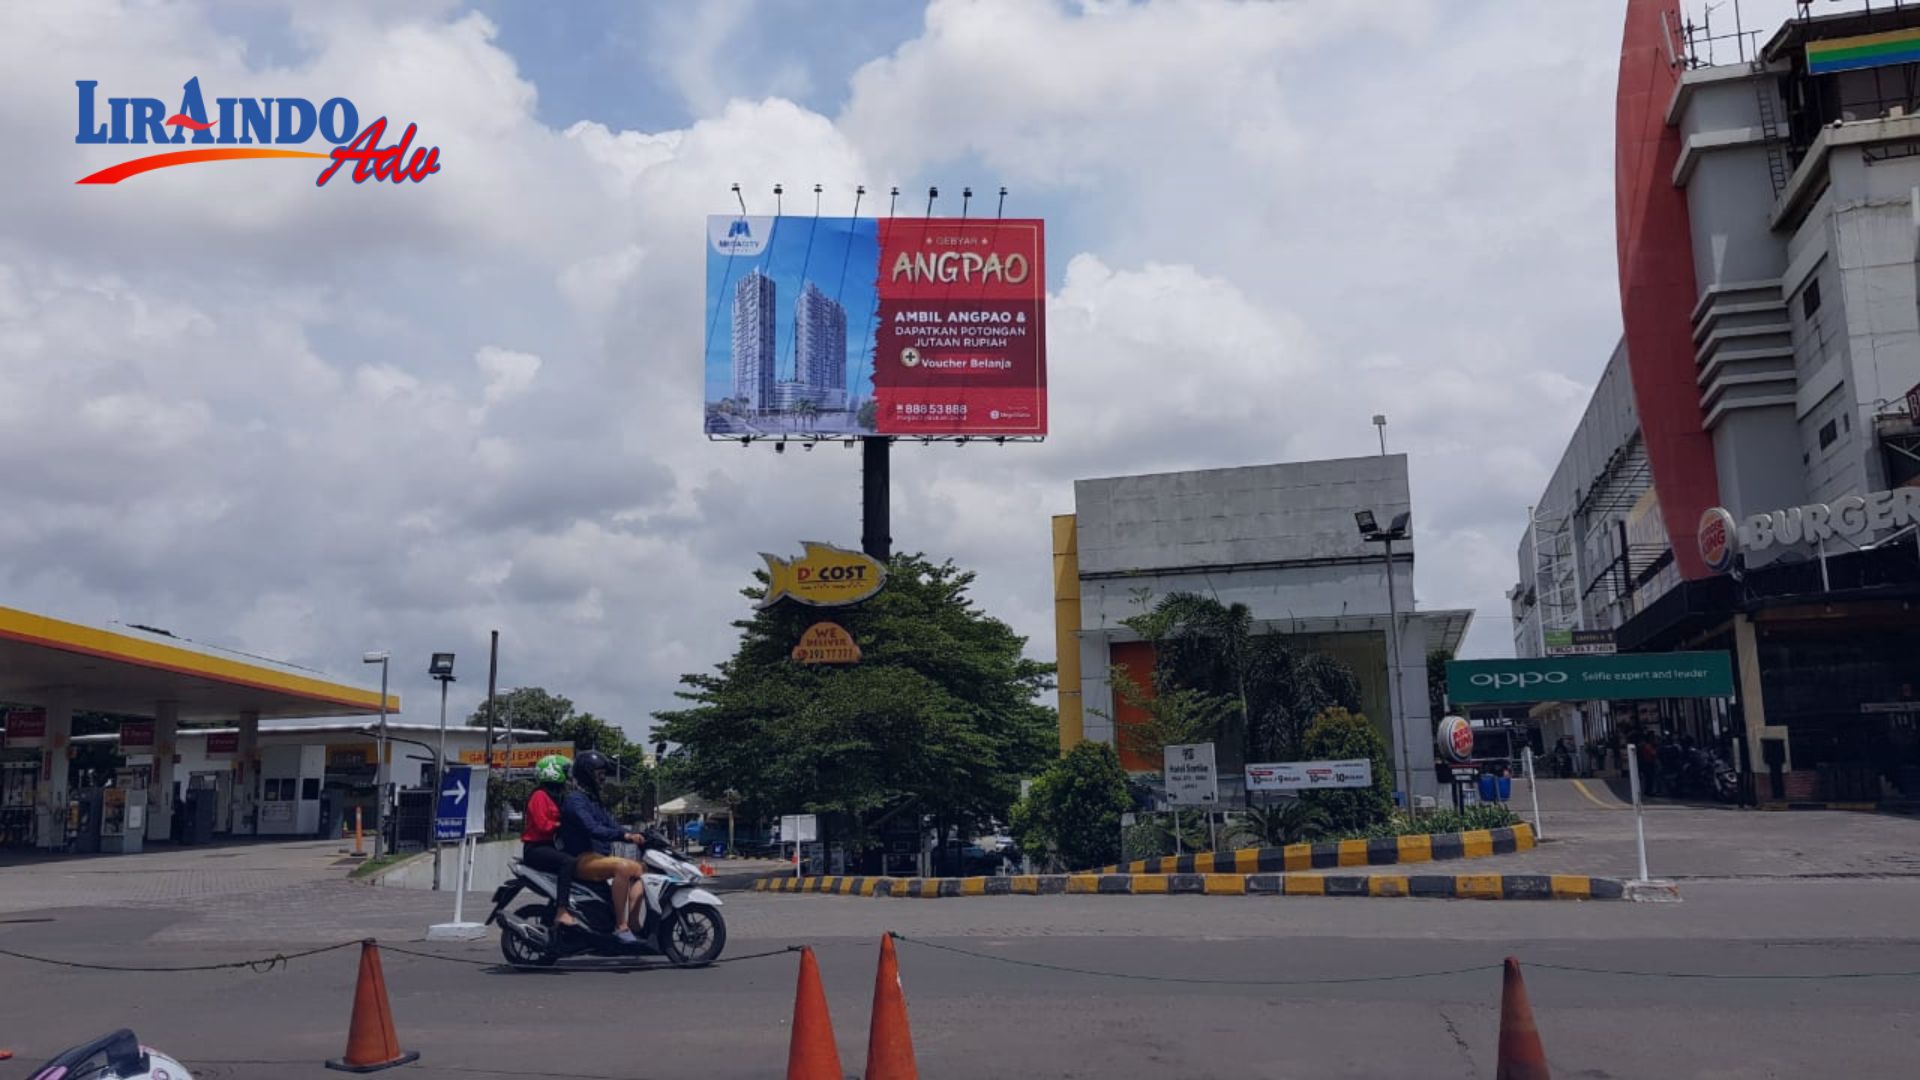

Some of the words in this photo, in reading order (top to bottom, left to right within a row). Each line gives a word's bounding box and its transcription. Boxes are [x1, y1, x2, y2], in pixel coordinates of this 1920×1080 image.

[891, 251, 1029, 284] ANGPAO
[894, 311, 943, 323] AMBIL
[947, 311, 1012, 323] ANGPAO
[1016, 311, 1026, 323] &
[895, 326, 957, 336] DAPATKAN
[961, 327, 1026, 336] POTONGAN
[914, 338, 960, 348] JUTAAN
[963, 338, 1008, 347] RUPIAH
[921, 358, 967, 368] Voucher
[970, 358, 1012, 370] Belanja
[1744, 486, 1920, 551] BURGER
[818, 565, 867, 580] COST
[815, 627, 837, 638] WE
[1582, 671, 1612, 682] Selfie
[1614, 671, 1650, 682] expert
[1652, 669, 1672, 680] and
[1674, 669, 1708, 679] leader
